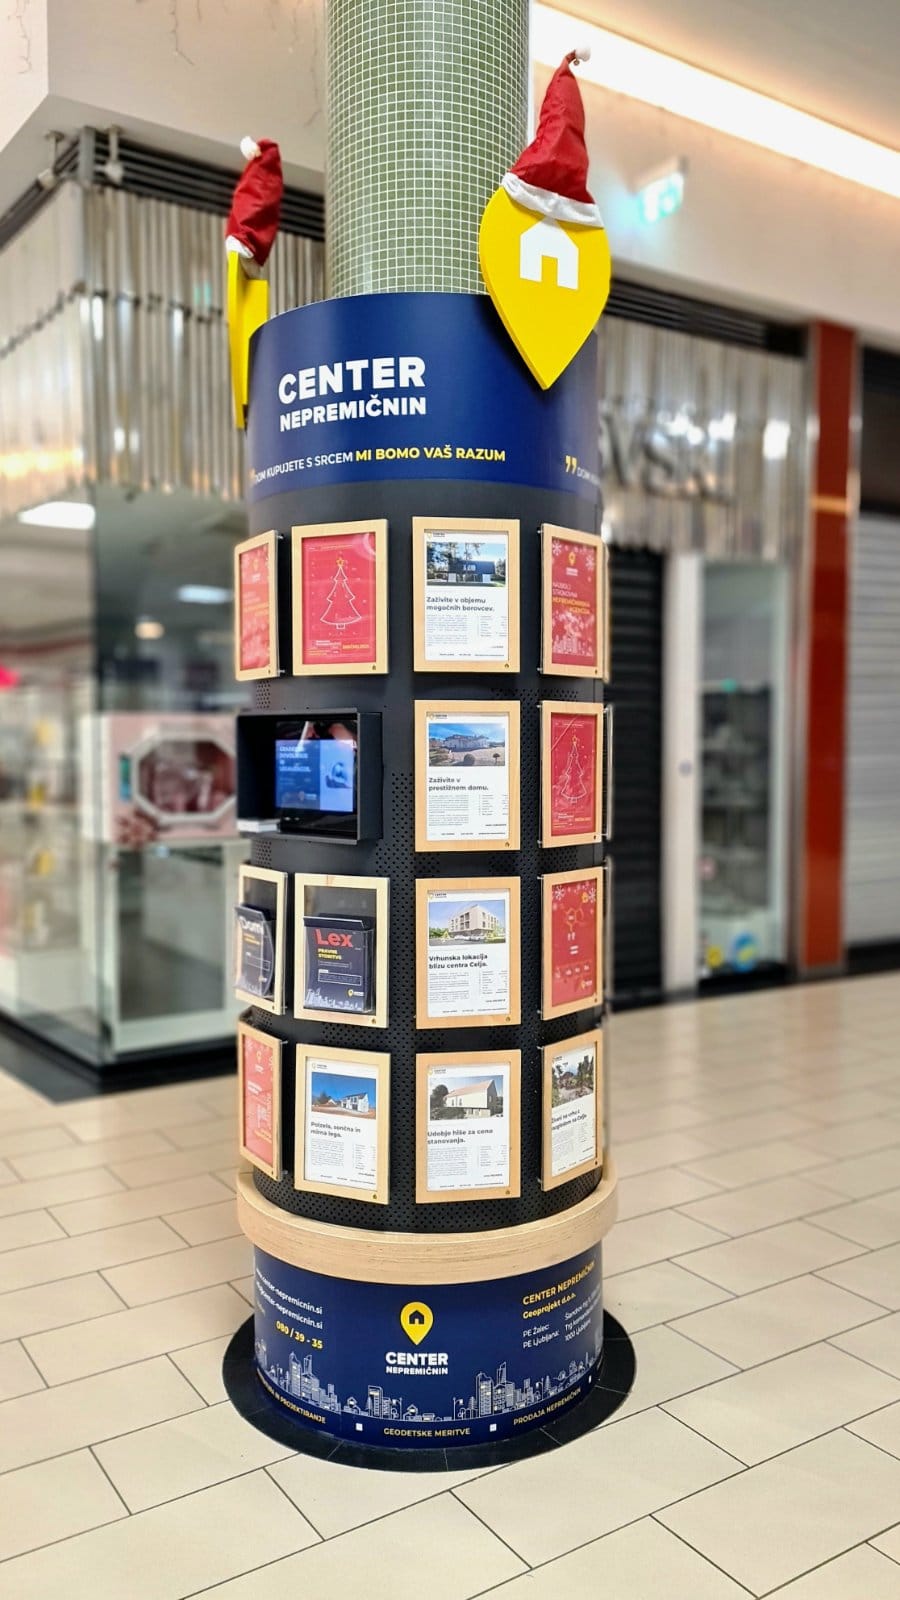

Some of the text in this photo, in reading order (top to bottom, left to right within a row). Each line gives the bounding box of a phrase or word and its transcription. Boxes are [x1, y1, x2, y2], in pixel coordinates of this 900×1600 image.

[278, 356, 426, 405] CENTER
[280, 394, 427, 432] NEPREMIČNIN
[266, 459, 304, 477] KUPUJETE
[306, 457, 313, 468] S
[315, 452, 353, 466] SRCEM
[356, 450, 371, 461] MI
[375, 447, 420, 460] BOMO
[423, 445, 452, 459] VAŠ
[456, 448, 506, 461] RAZUM
[461, 596, 486, 604] objemu
[429, 784, 466, 792] prestižnem
[315, 928, 353, 948] Lex
[256, 1267, 323, 1314] .center-nepremicnin.si
[522, 1286, 556, 1305] CENTER
[522, 1299, 560, 1319] Geoprojekt
[276, 1320, 289, 1335] 080
[295, 1331, 305, 1343] 39
[311, 1338, 323, 1349] 35
[523, 1341, 532, 1349] PE
[385, 1351, 449, 1366] CENTER
[385, 1366, 449, 1376] NEPREMIČNIN
[513, 1408, 546, 1426] PRODAJA
[383, 1427, 471, 1437] GEODETSKE MERITVE
